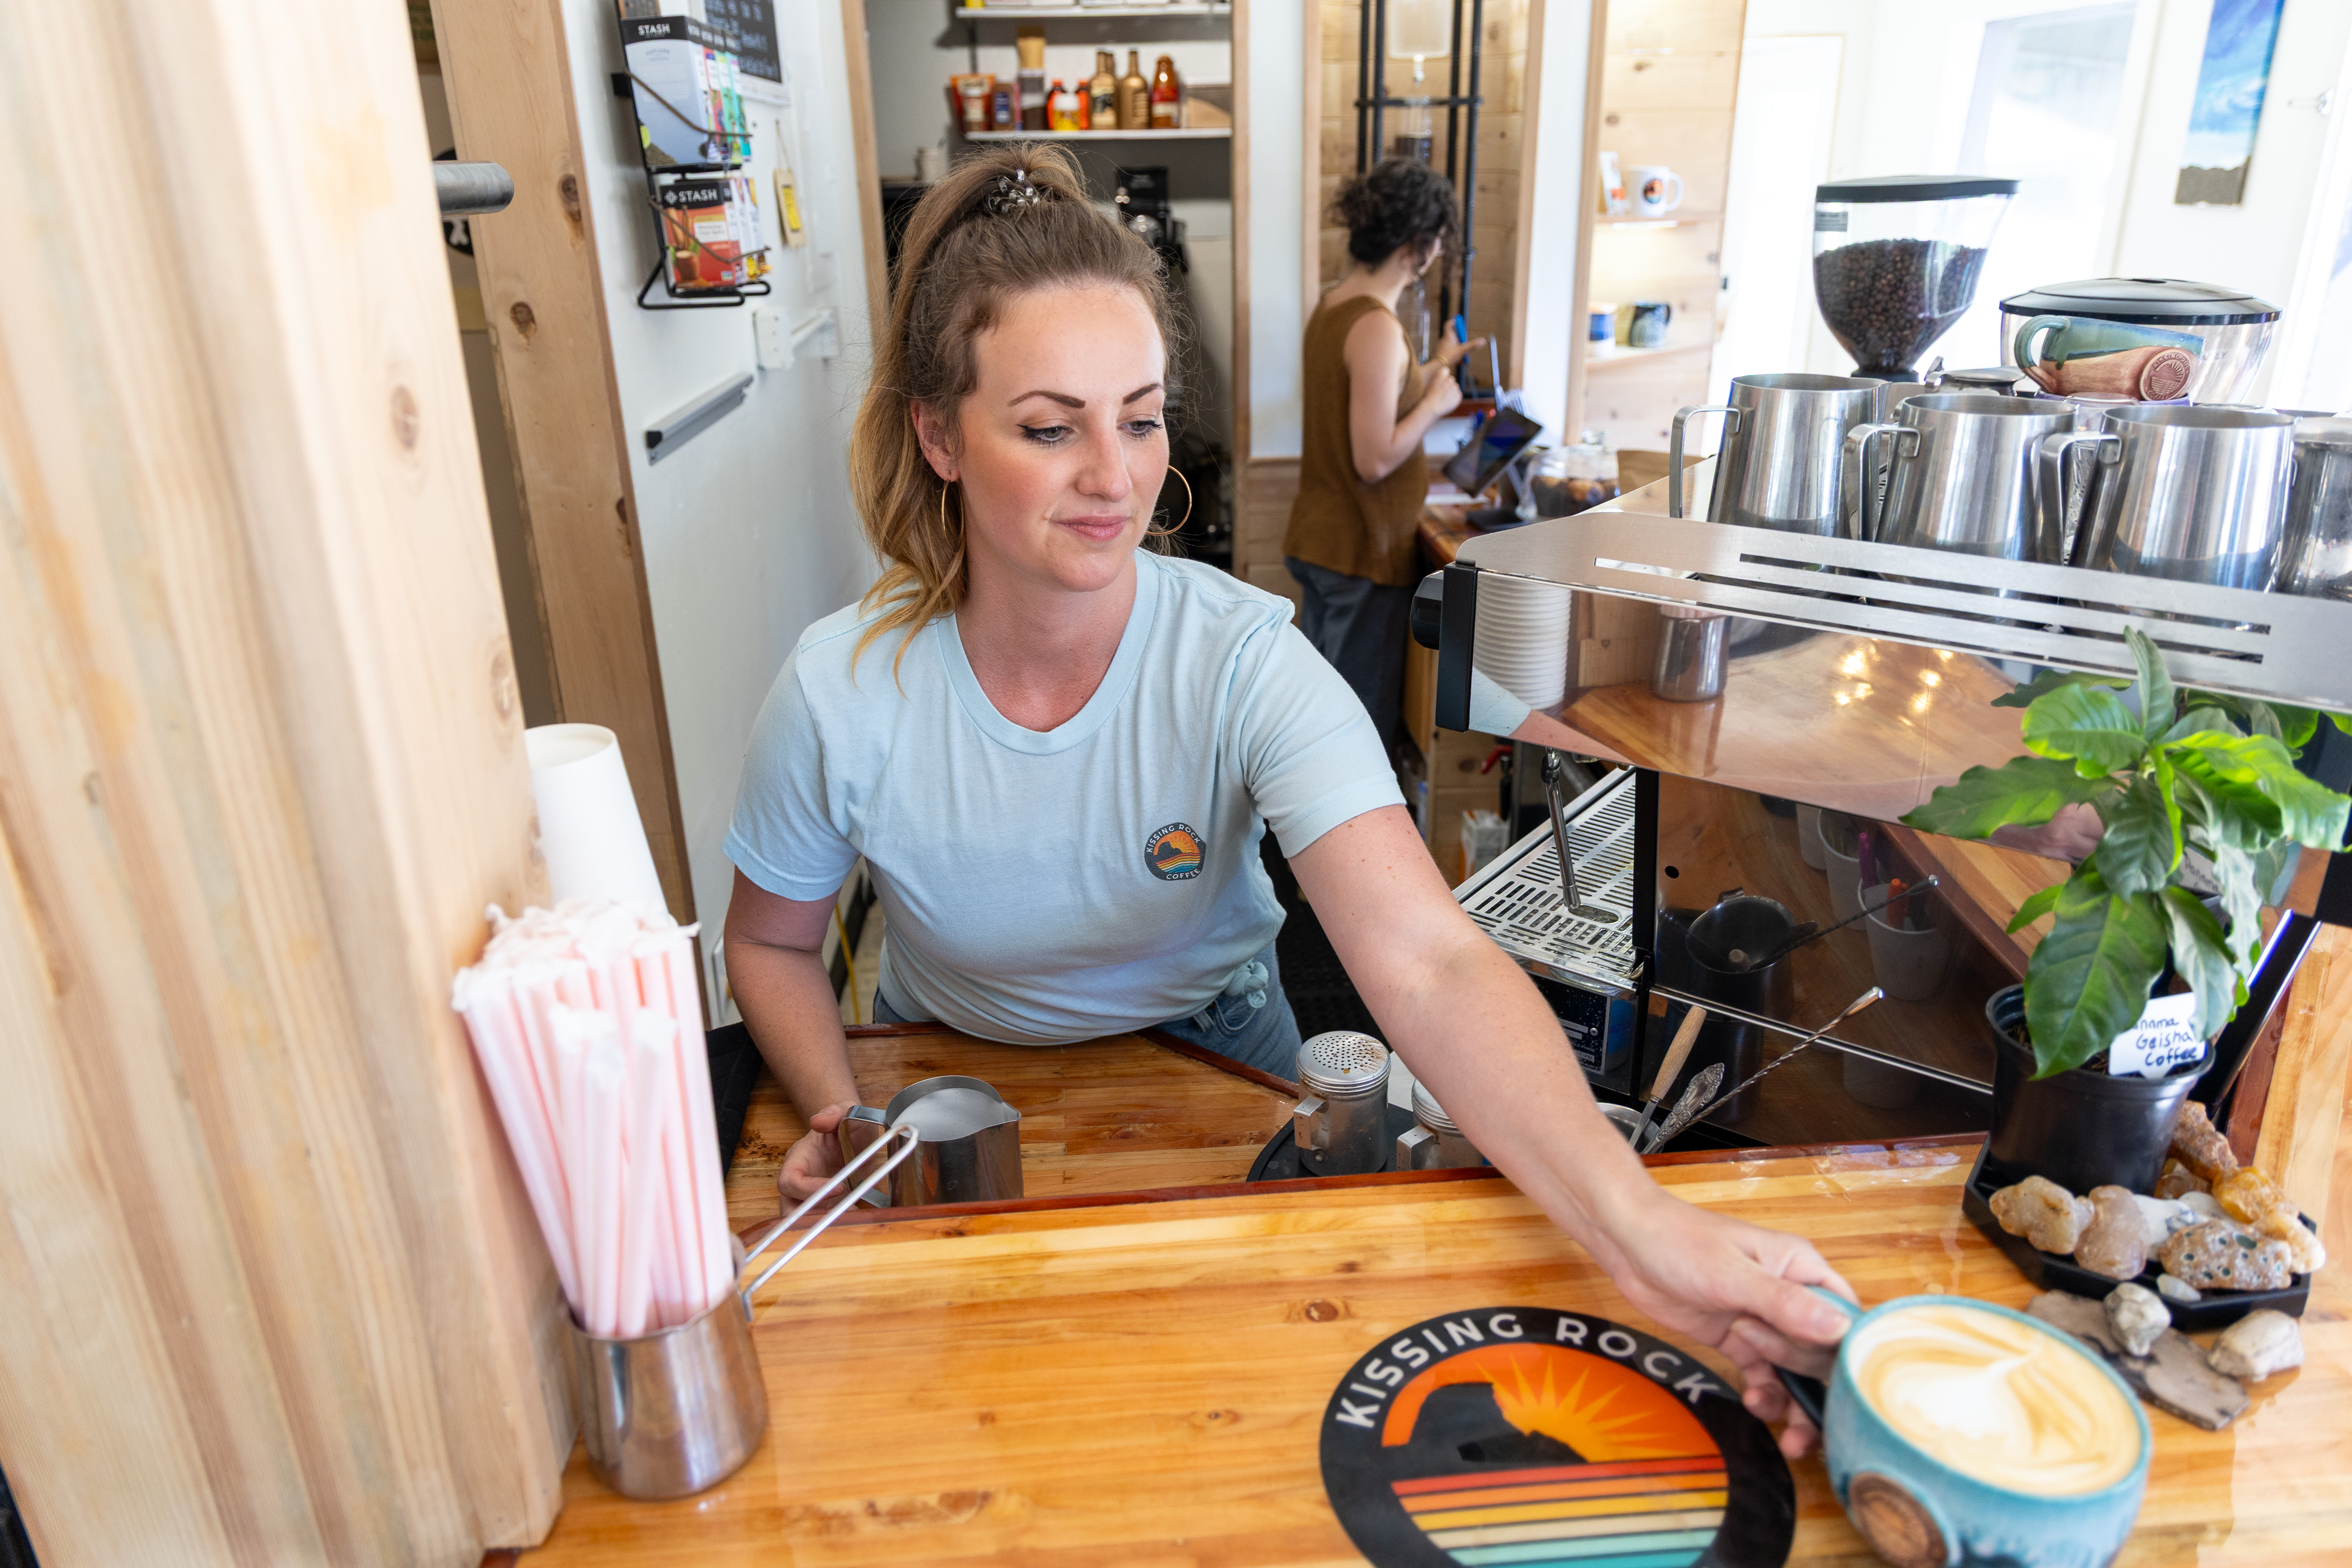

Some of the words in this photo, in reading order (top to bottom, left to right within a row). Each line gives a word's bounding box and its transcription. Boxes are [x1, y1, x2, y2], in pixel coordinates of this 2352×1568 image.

[638, 23, 670, 36] STASH
[679, 189, 718, 203] STASH
[1147, 826, 1174, 853] KISSING
[1179, 824, 1200, 843] ROCK
[1166, 869, 1201, 879] COFFEE
[2137, 1018, 2179, 1031] nama
[2136, 1031, 2193, 1049] Geisha
[2145, 1047, 2197, 1066] Coffee
[1335, 1314, 1524, 1428] KISSING
[1556, 1316, 1721, 1404] ROCK
